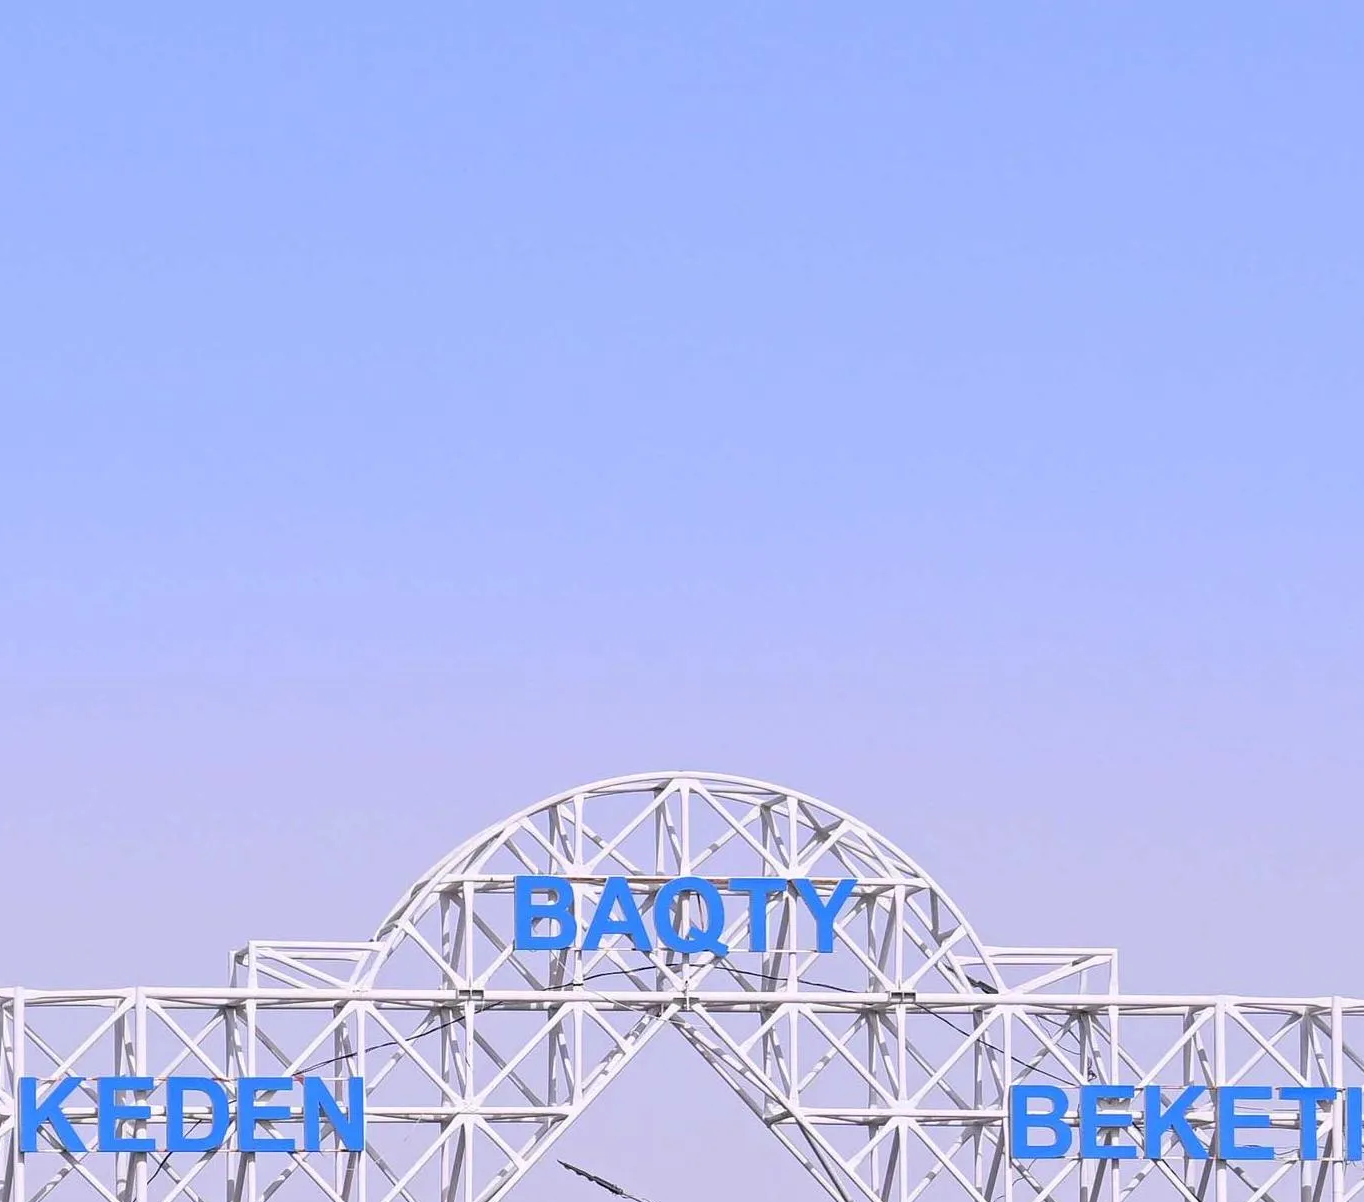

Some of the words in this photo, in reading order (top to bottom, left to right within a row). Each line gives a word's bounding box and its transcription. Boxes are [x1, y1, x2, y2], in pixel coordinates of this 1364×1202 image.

[514, 875, 858, 957] BAQTY
[19, 1076, 366, 1153] KEDEN
[1010, 1084, 1363, 1161] BEKETI
